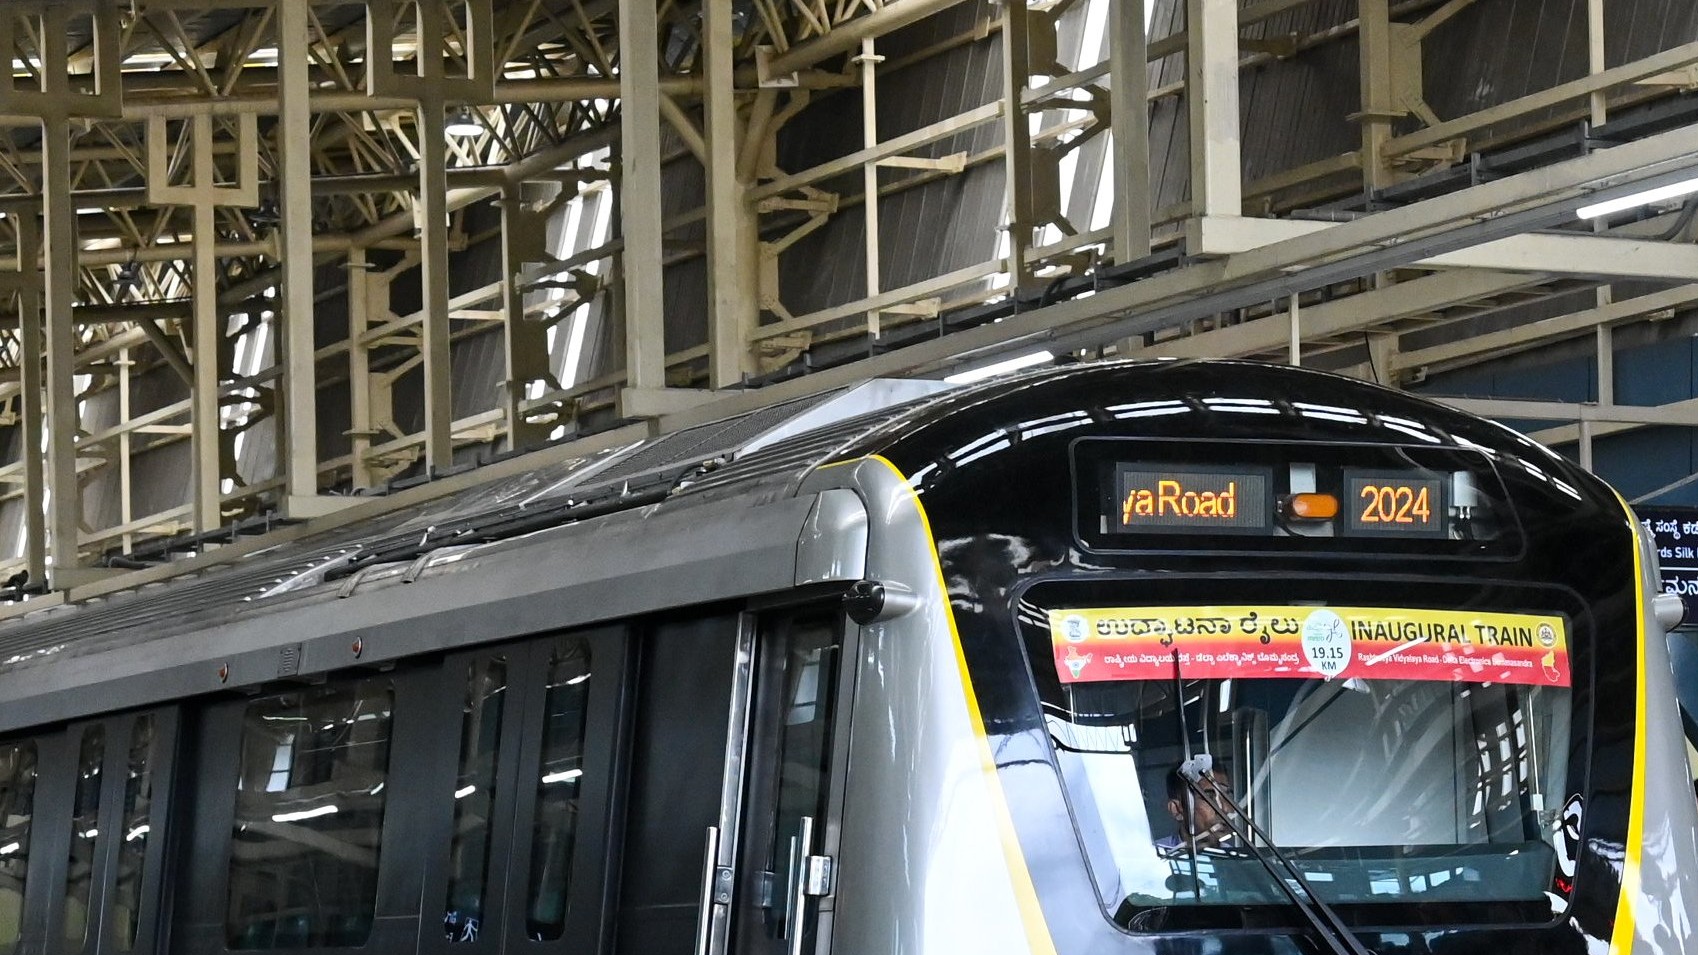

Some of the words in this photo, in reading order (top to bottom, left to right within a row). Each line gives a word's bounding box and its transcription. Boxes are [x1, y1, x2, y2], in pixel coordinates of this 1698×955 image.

[1158, 480, 1235, 518] Road
[1360, 485, 1430, 524] 2024
[1675, 546, 1694, 559] Silk
[1239, 611, 1300, 645] ರೈಲು
[1351, 620, 1471, 643] INAUGURAL
[1474, 624, 1534, 647] TRAIN
[1312, 647, 1344, 658] 19.15
[1423, 655, 1440, 664] Road
[1321, 660, 1337, 671] KM
